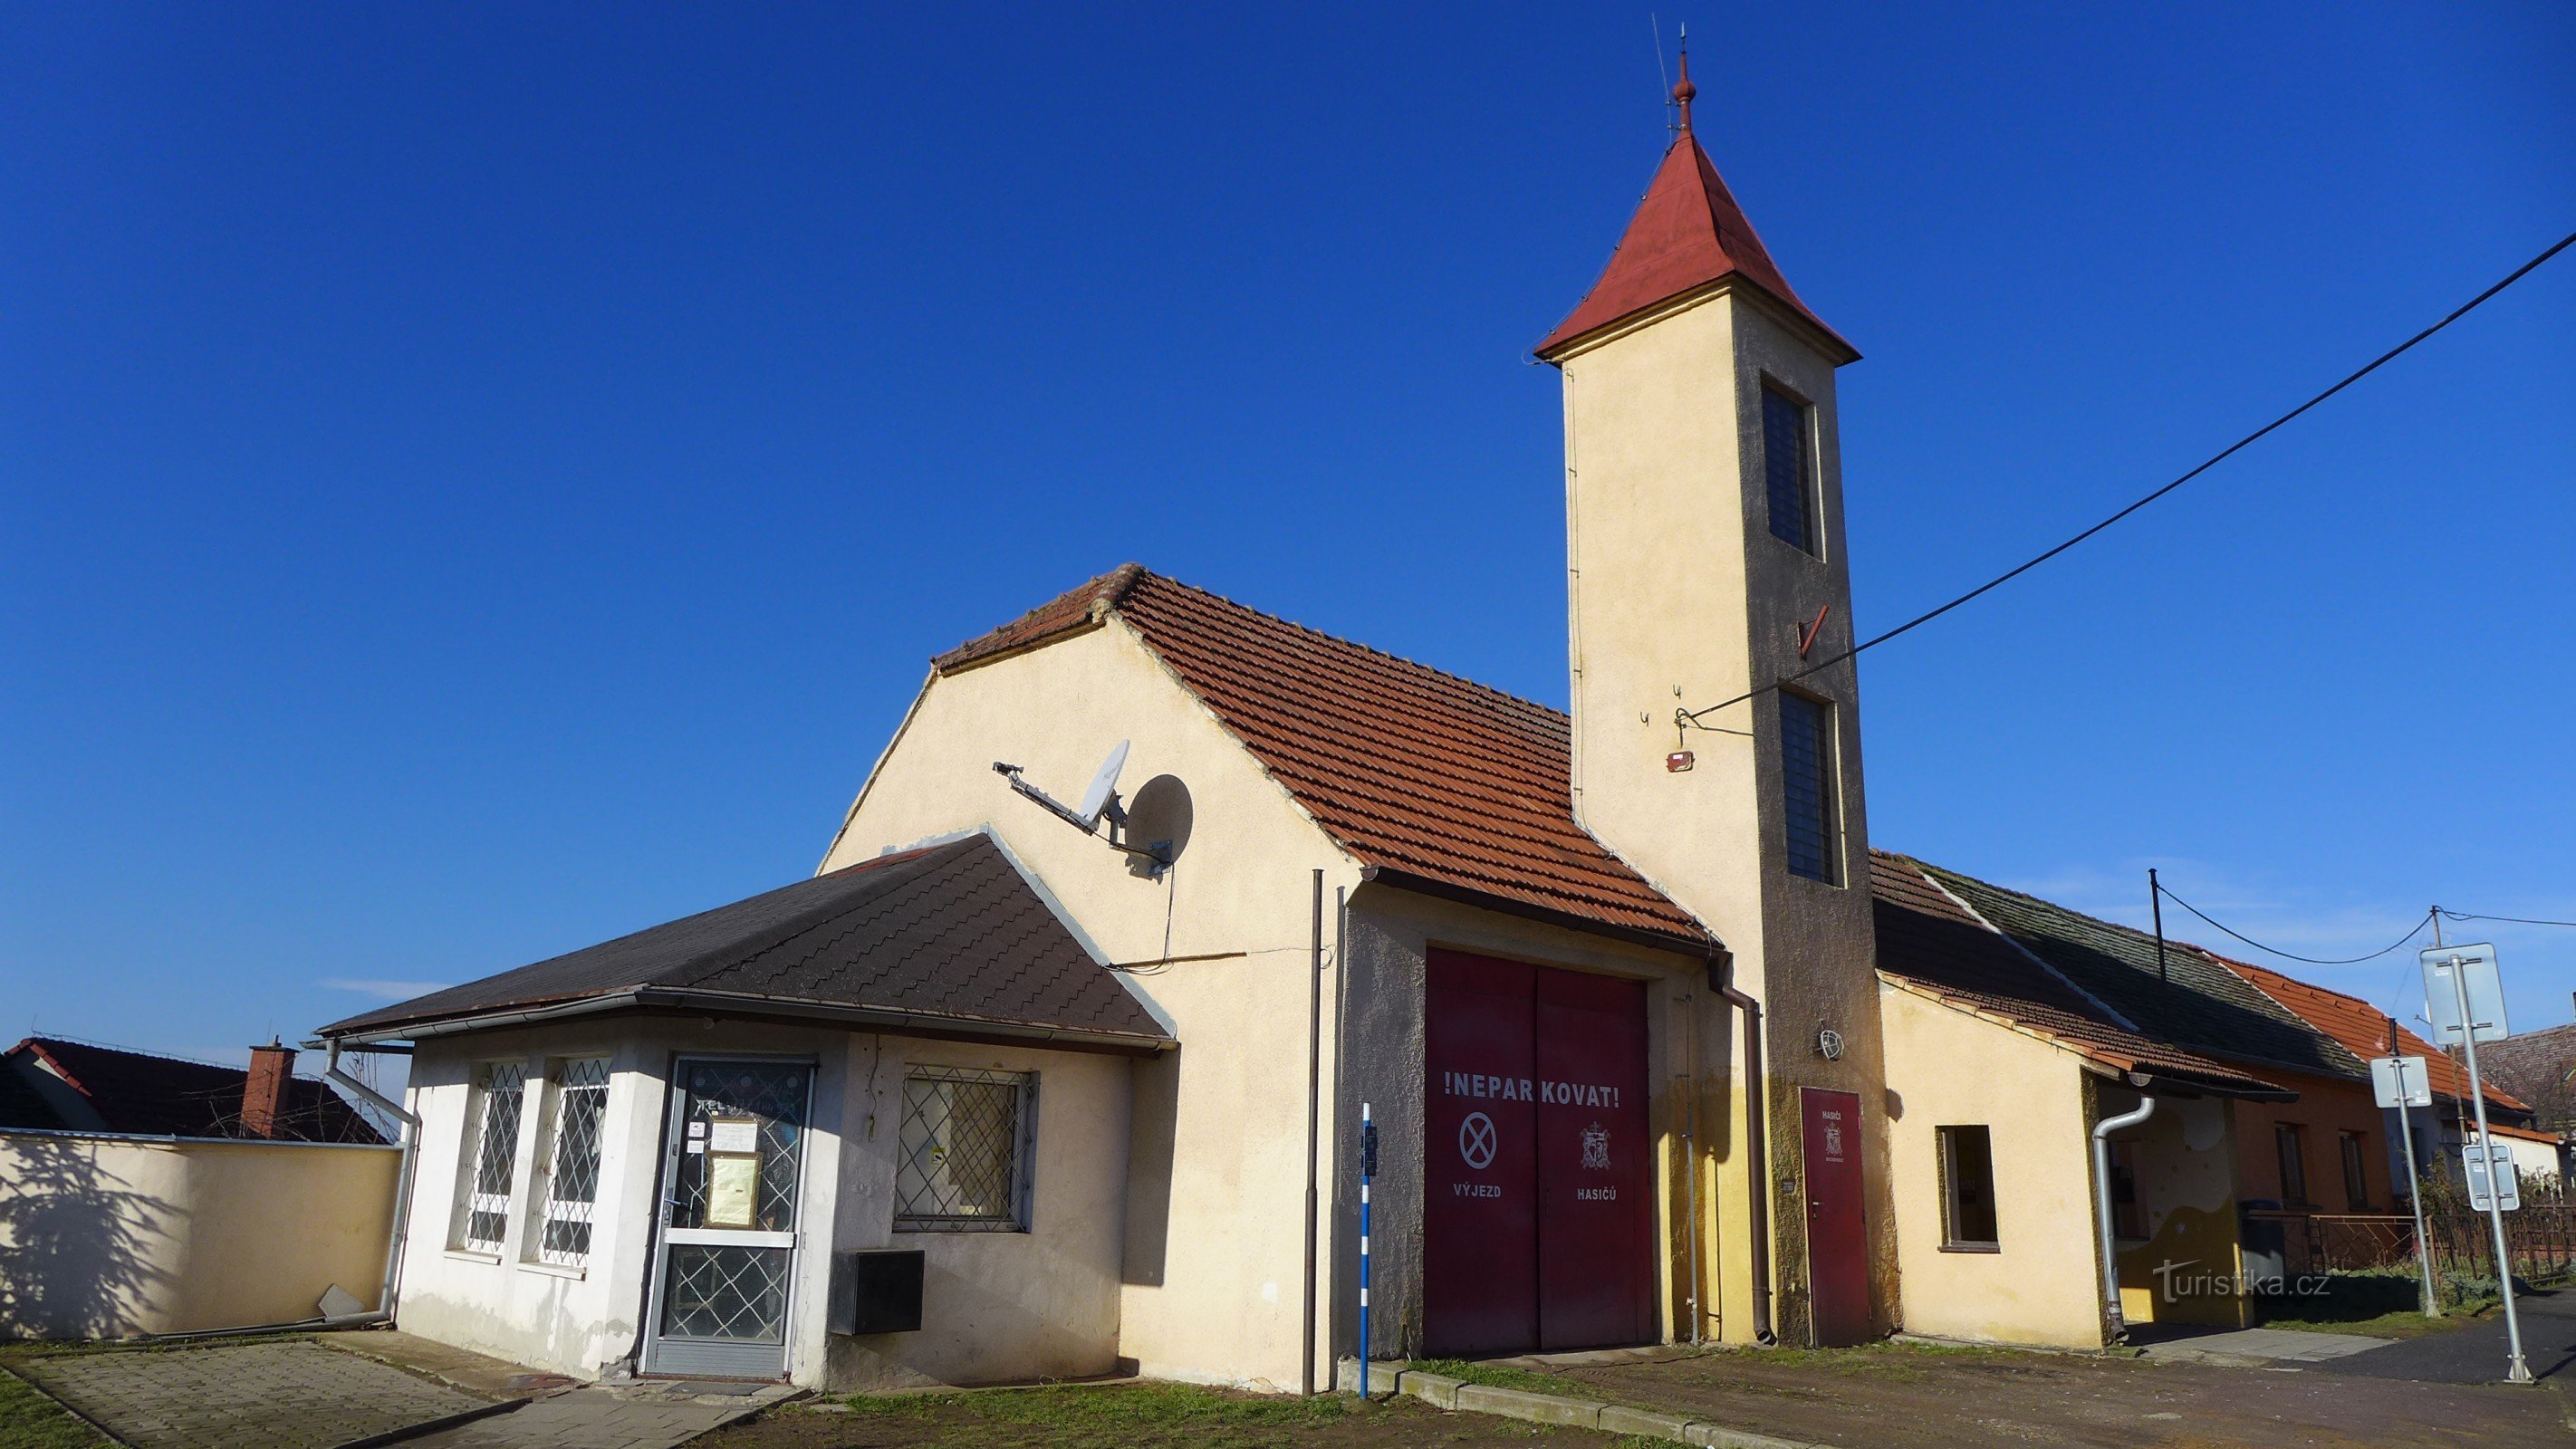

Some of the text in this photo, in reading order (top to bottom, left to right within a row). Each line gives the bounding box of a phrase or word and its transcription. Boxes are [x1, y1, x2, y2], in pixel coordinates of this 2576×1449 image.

[1445, 1071, 1620, 1108] !NEPAR KOVAT!
[1453, 1181, 1501, 1198] VÝJEZD
